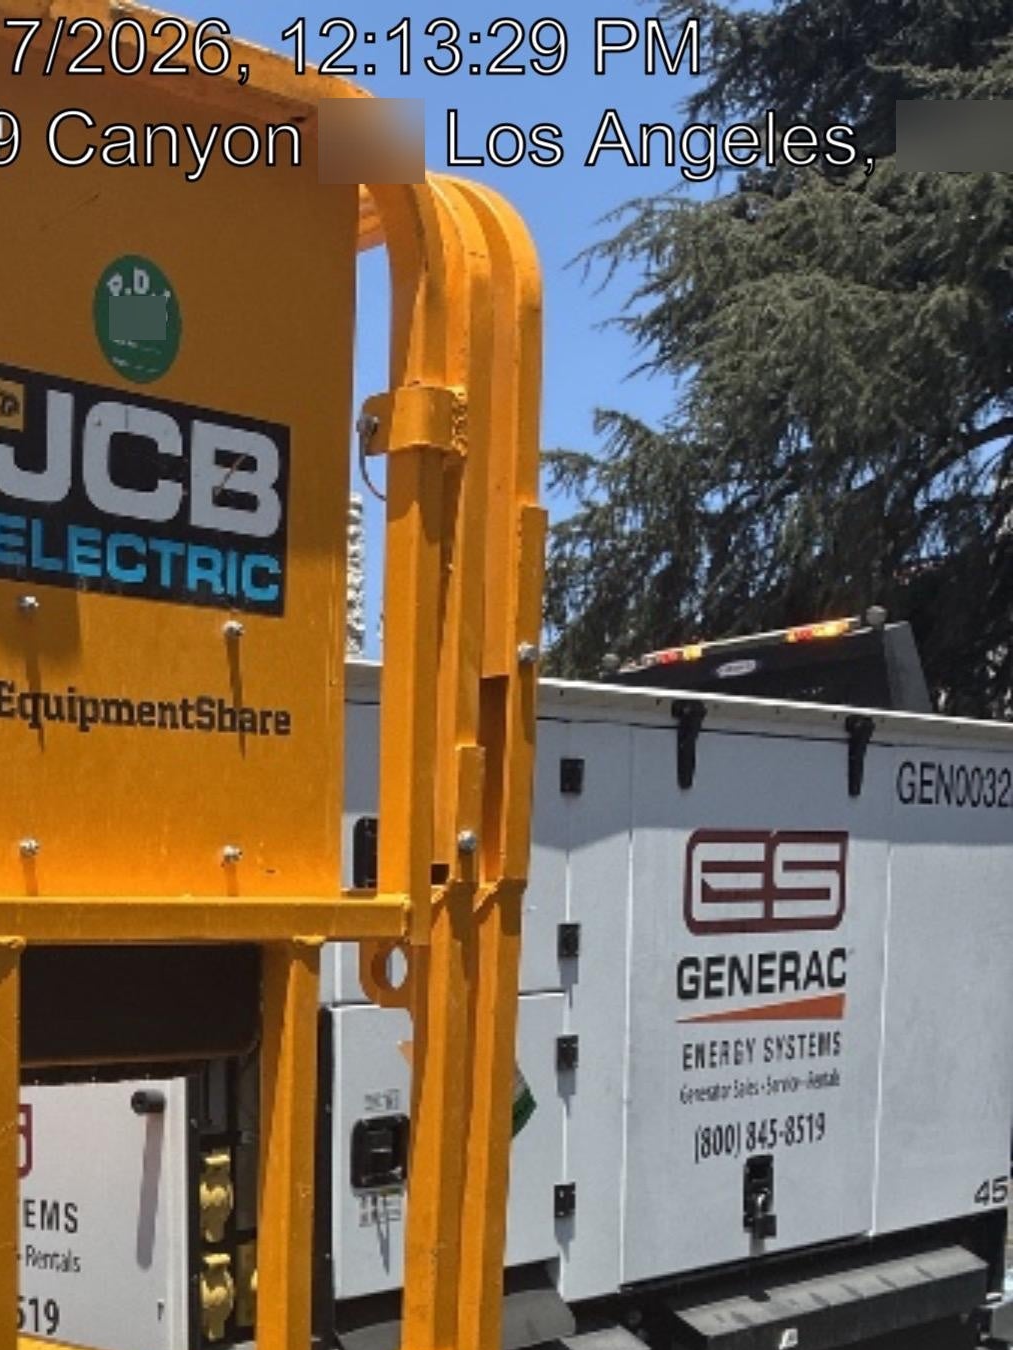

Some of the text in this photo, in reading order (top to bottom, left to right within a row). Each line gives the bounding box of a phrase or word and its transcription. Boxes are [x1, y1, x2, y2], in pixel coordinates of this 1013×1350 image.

[676, 947, 848, 1001] GENERAC
[682, 1030, 841, 1071] ENERGY SYSTEMS
[695, 1112, 825, 1164] (800) 845-8519
